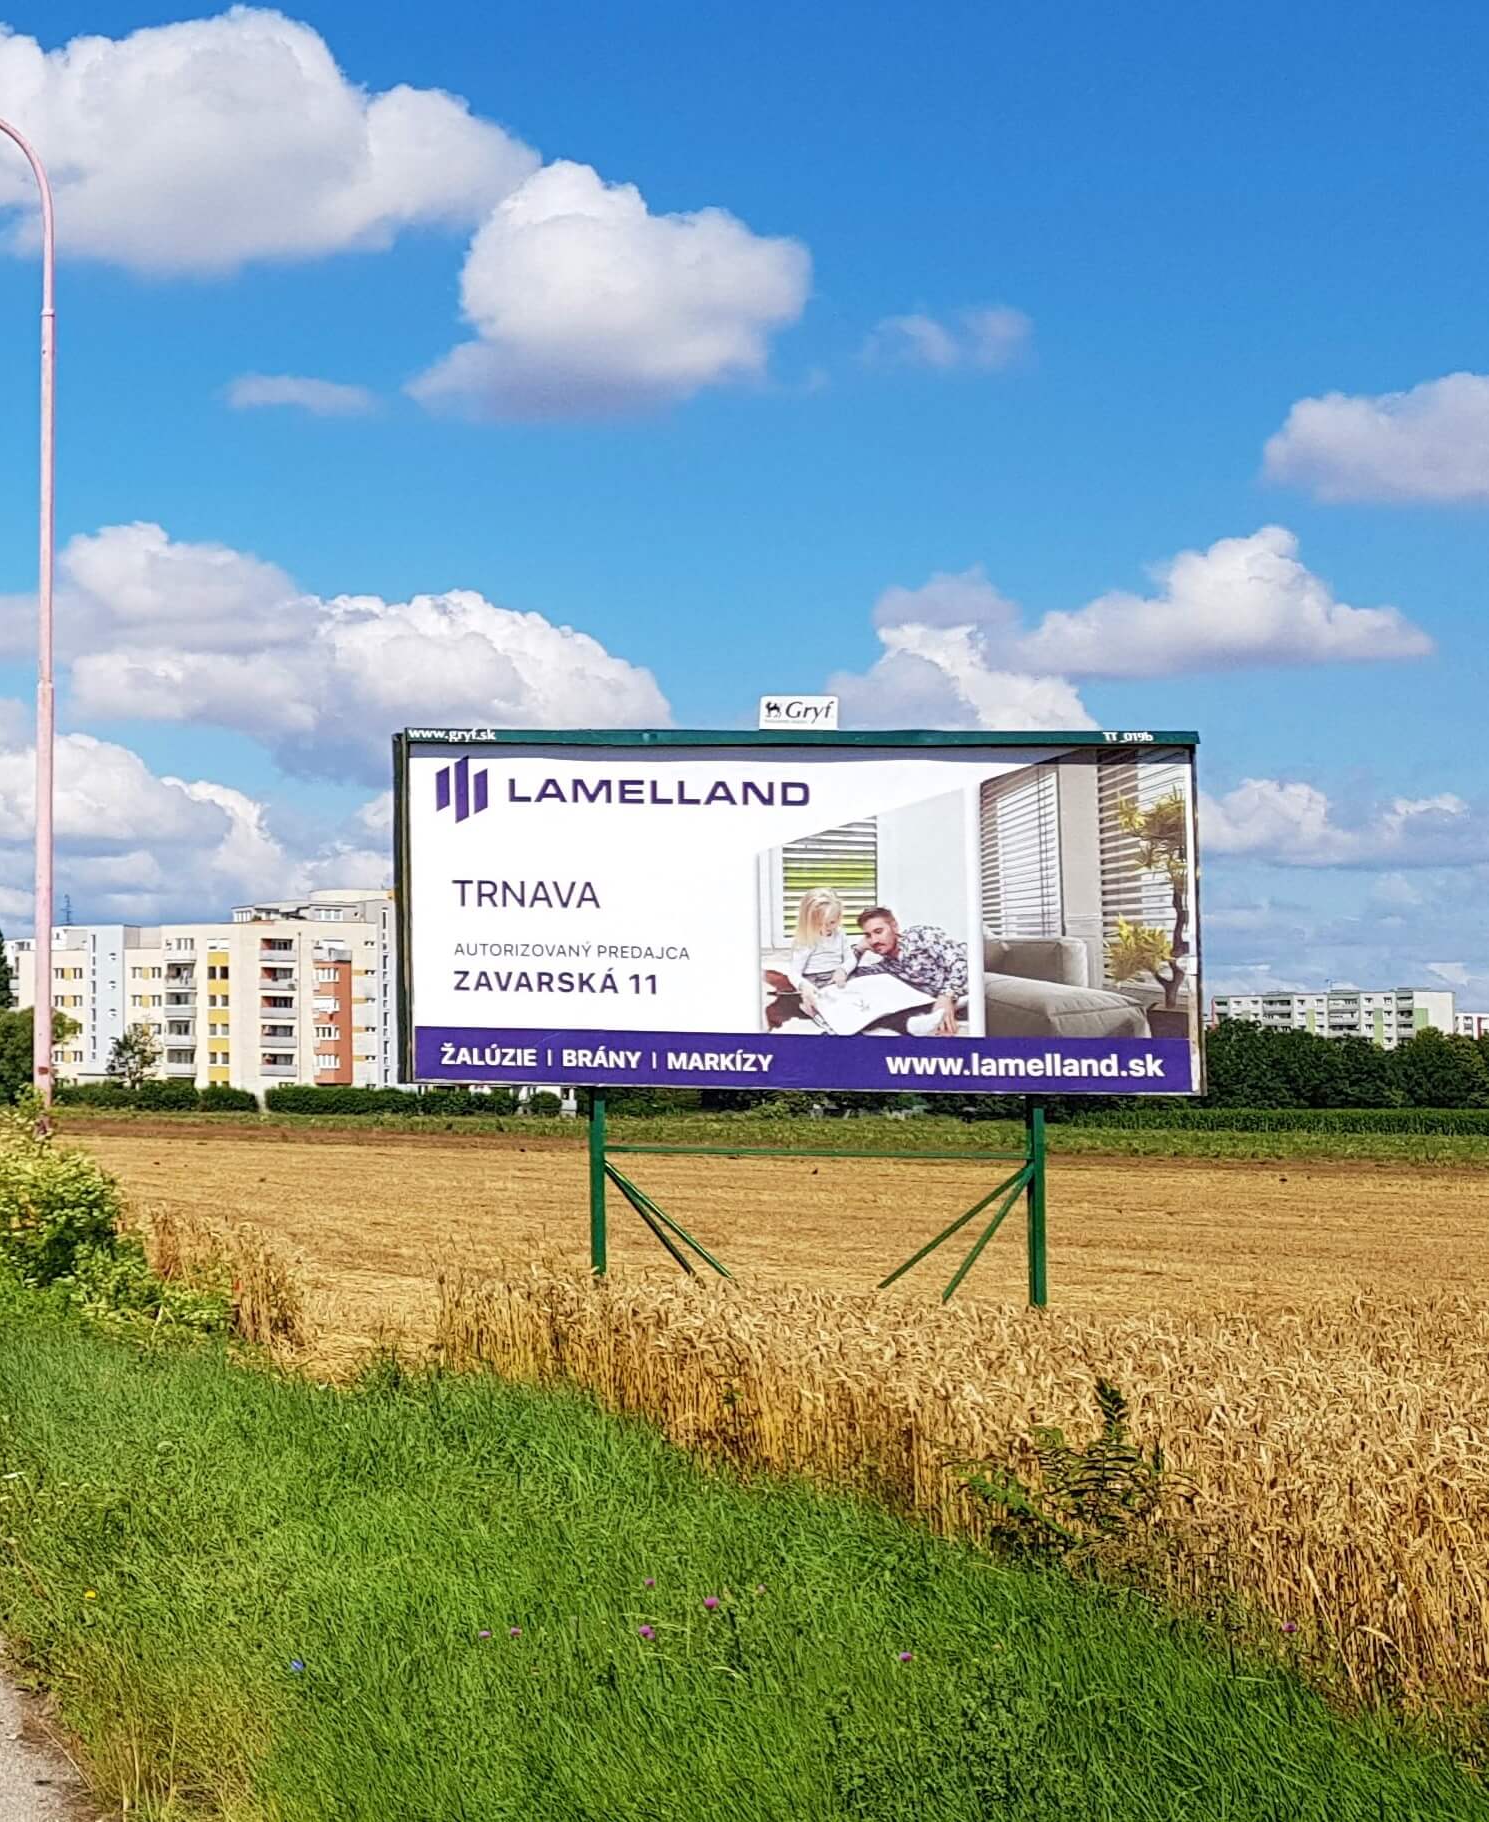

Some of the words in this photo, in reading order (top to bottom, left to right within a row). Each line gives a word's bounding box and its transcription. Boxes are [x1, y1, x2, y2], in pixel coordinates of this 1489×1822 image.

[785, 701, 835, 724] Gryf
[408, 728, 496, 742] www.gryf.sk
[508, 778, 810, 806] LAMELLAND
[452, 879, 601, 909] TRNAVA
[454, 941, 592, 958] AUTORIZOVANÝ
[597, 945, 690, 960] PREDAJCA
[453, 967, 619, 994] ZAVARSKÁ
[628, 973, 657, 995] 11
[440, 1043, 538, 1067] ŽALÚZIE
[562, 1046, 641, 1069] BRÁNY
[666, 1050, 773, 1072] MARKÍZY
[885, 1052, 1166, 1078] www.lamelland.sk
